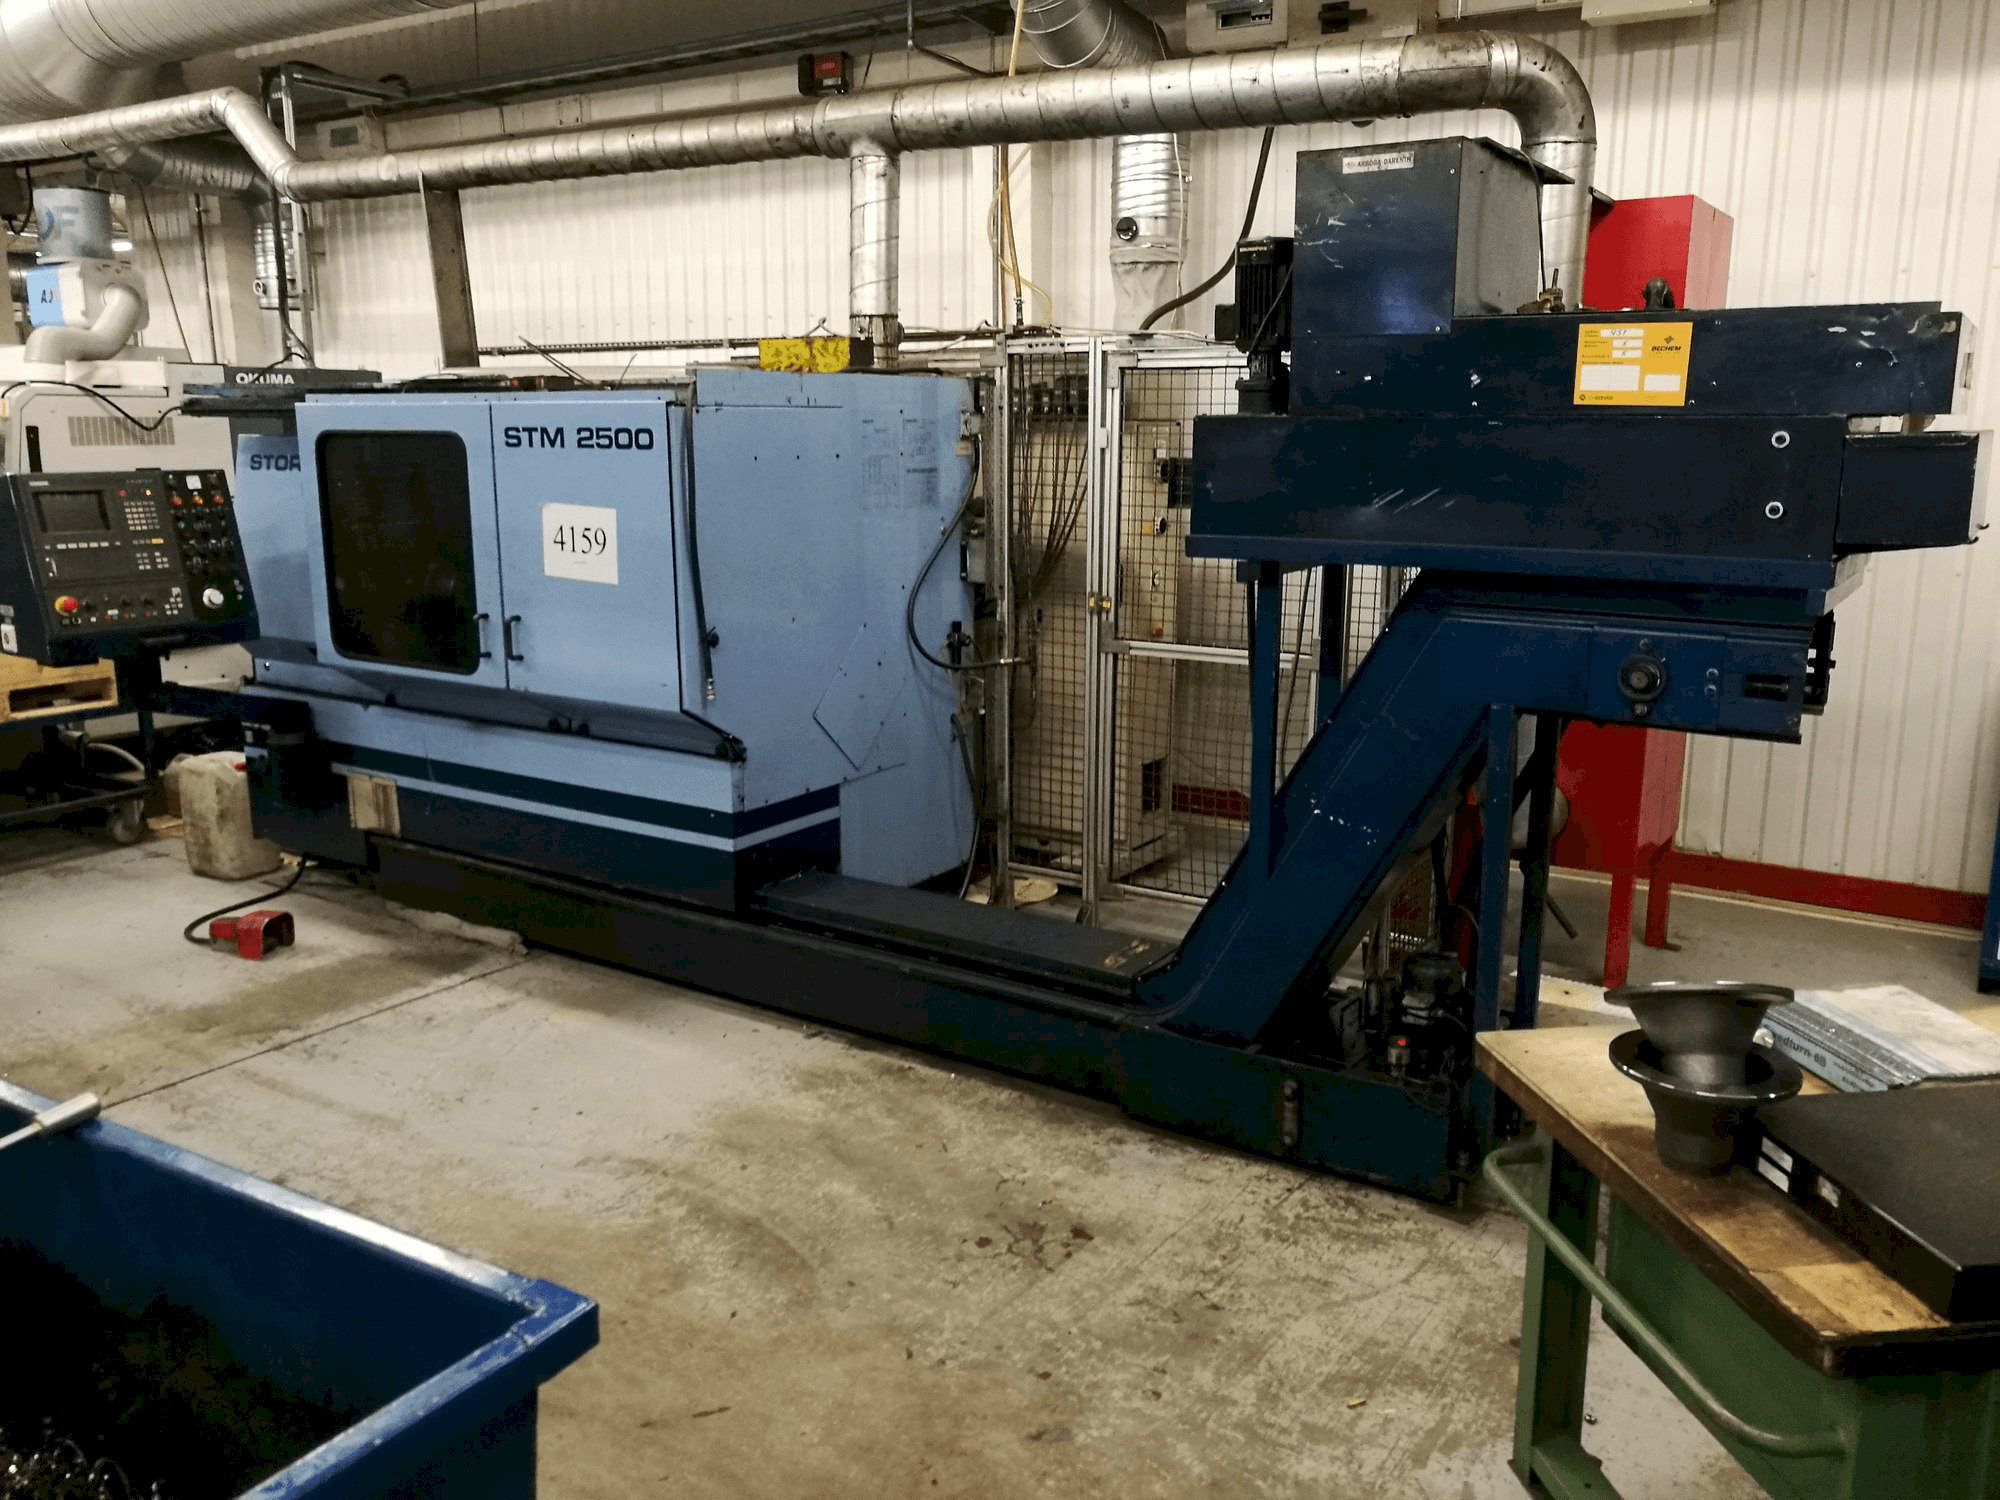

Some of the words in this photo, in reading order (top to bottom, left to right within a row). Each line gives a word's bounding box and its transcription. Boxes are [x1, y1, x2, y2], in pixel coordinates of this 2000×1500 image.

[235, 372, 296, 385] OKUMA
[504, 426, 565, 449] STM
[576, 426, 654, 450] 2500
[250, 454, 301, 472] STOR
[552, 523, 607, 556] 4159
